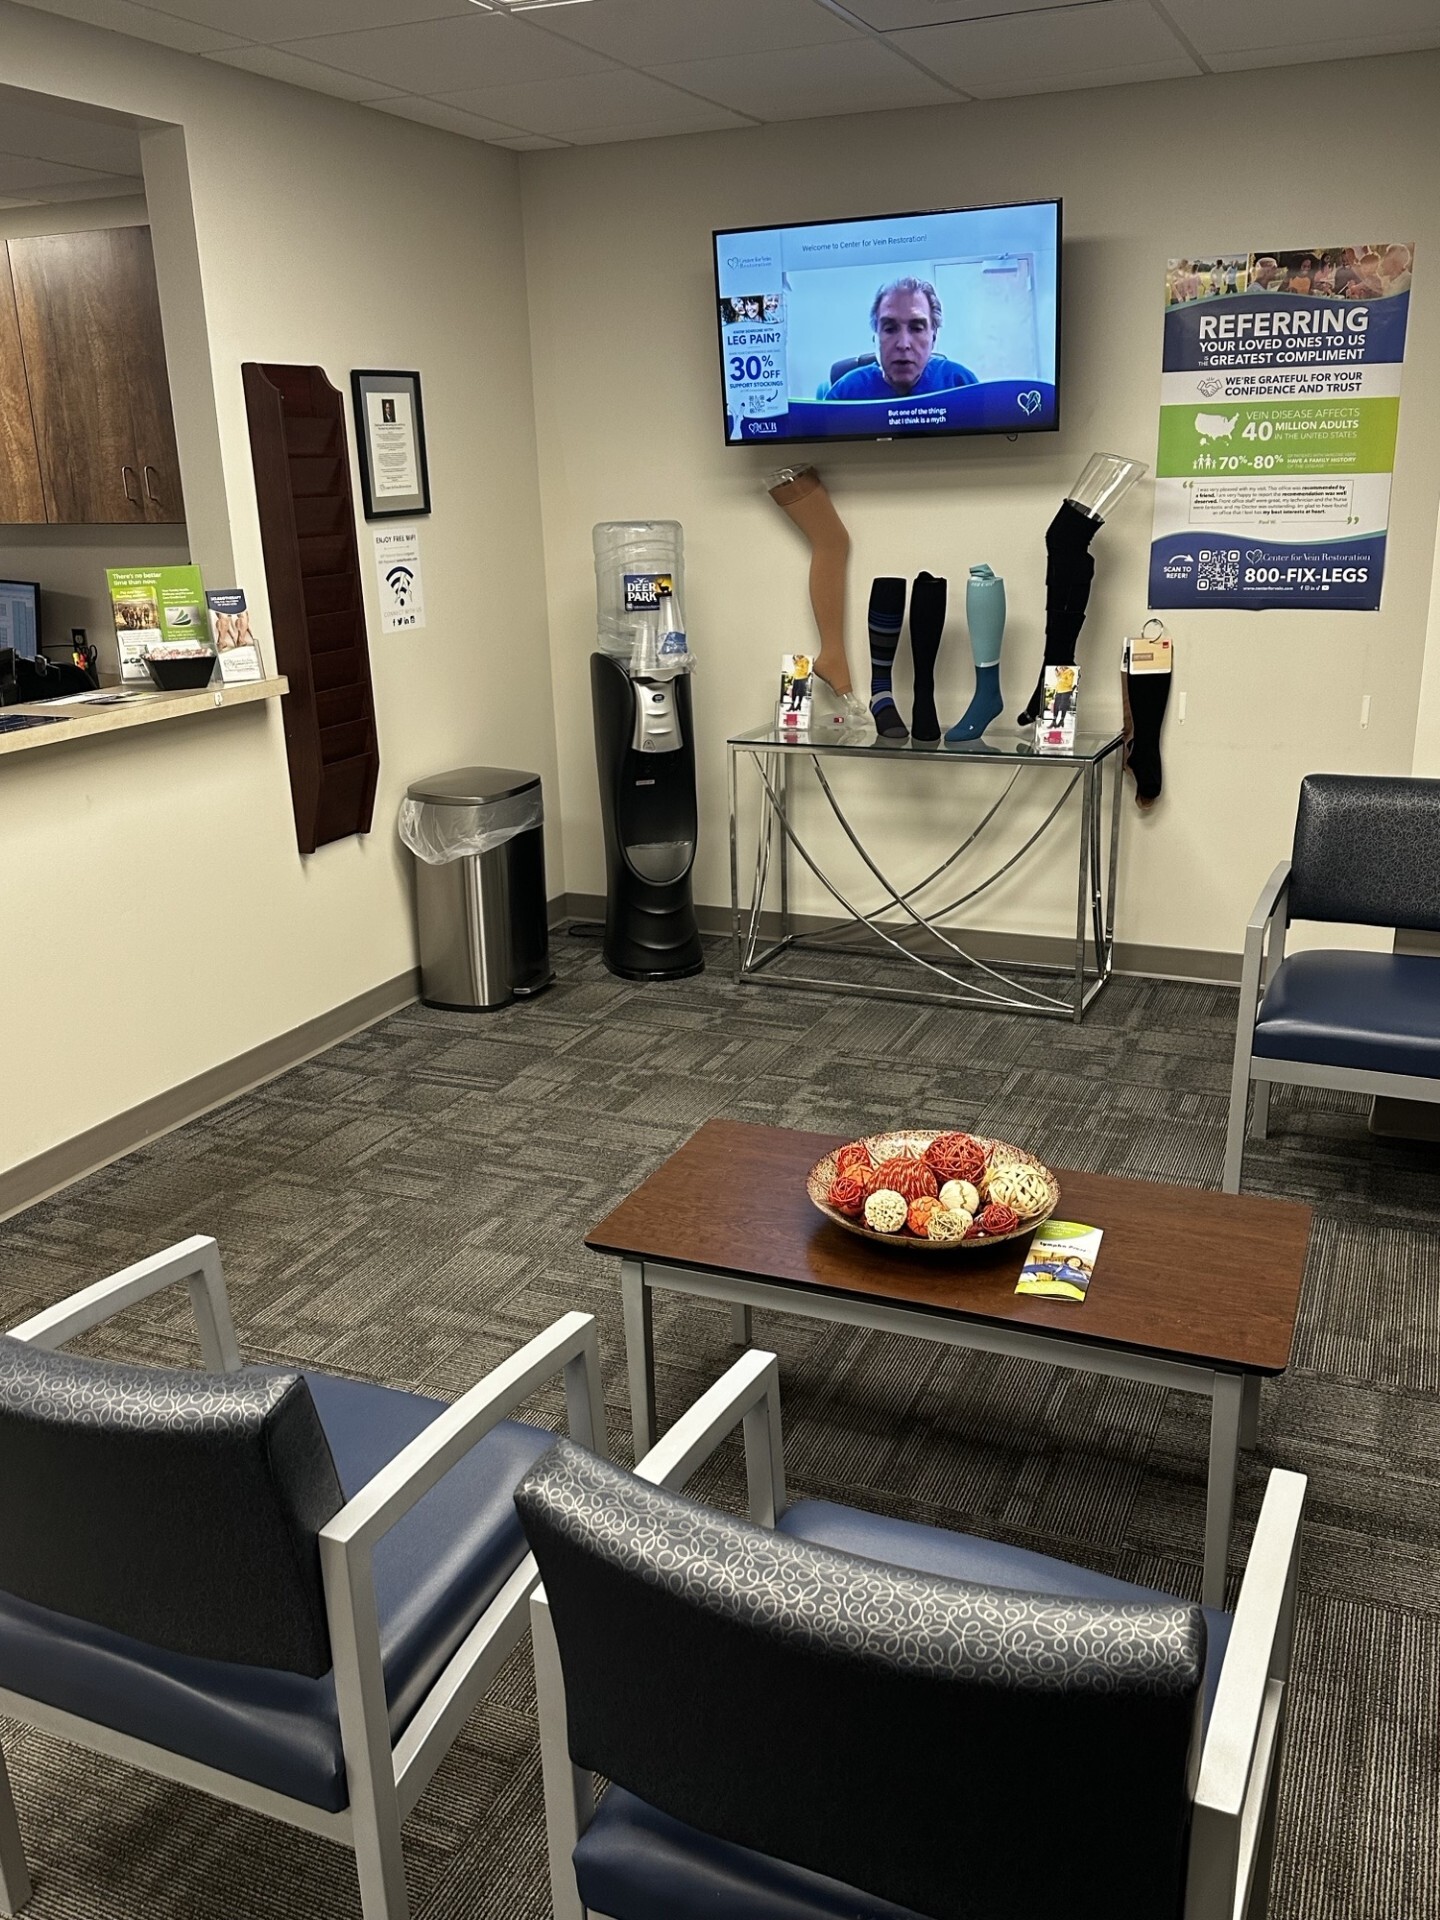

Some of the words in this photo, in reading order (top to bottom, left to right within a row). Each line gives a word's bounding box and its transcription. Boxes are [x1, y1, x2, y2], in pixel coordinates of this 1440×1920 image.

[802, 244, 831, 252] Welcome
[1199, 307, 1368, 340] REFERRING
[728, 336, 746, 346] LEG
[750, 332, 780, 344] PAIN?
[1200, 341, 1235, 352] YOUR
[1239, 339, 1282, 350] LOVED
[1286, 337, 1322, 348] ONES
[1326, 336, 1344, 347] TO
[1348, 335, 1366, 346] US
[1210, 353, 1273, 366] GREATEST
[1276, 349, 1365, 363] COMPLIMENT
[762, 370, 780, 379] OFF
[1226, 376, 1256, 385] WE'RE
[1258, 374, 1308, 384] GRATEFUL
[1310, 373, 1331, 382] FOR
[1334, 372, 1362, 381] YOUR
[1225, 385, 1295, 396] CONFIDENCE
[1298, 384, 1323, 393] AND
[1326, 382, 1362, 392] TRUST
[931, 416, 946, 424] myth
[1246, 410, 1269, 420] VEIN
[1272, 409, 1313, 419] DISEASE
[1315, 408, 1360, 418] AFFECTS
[1242, 422, 1273, 441] 40
[1276, 422, 1317, 430] MILLION
[1319, 420, 1359, 429] ADULTS
[1219, 454, 1284, 470] 70%-80%
[1244, 568, 1368, 583] 800-FIX-LEGS
[627, 583, 656, 591] DEER
[628, 592, 657, 602] PARK
